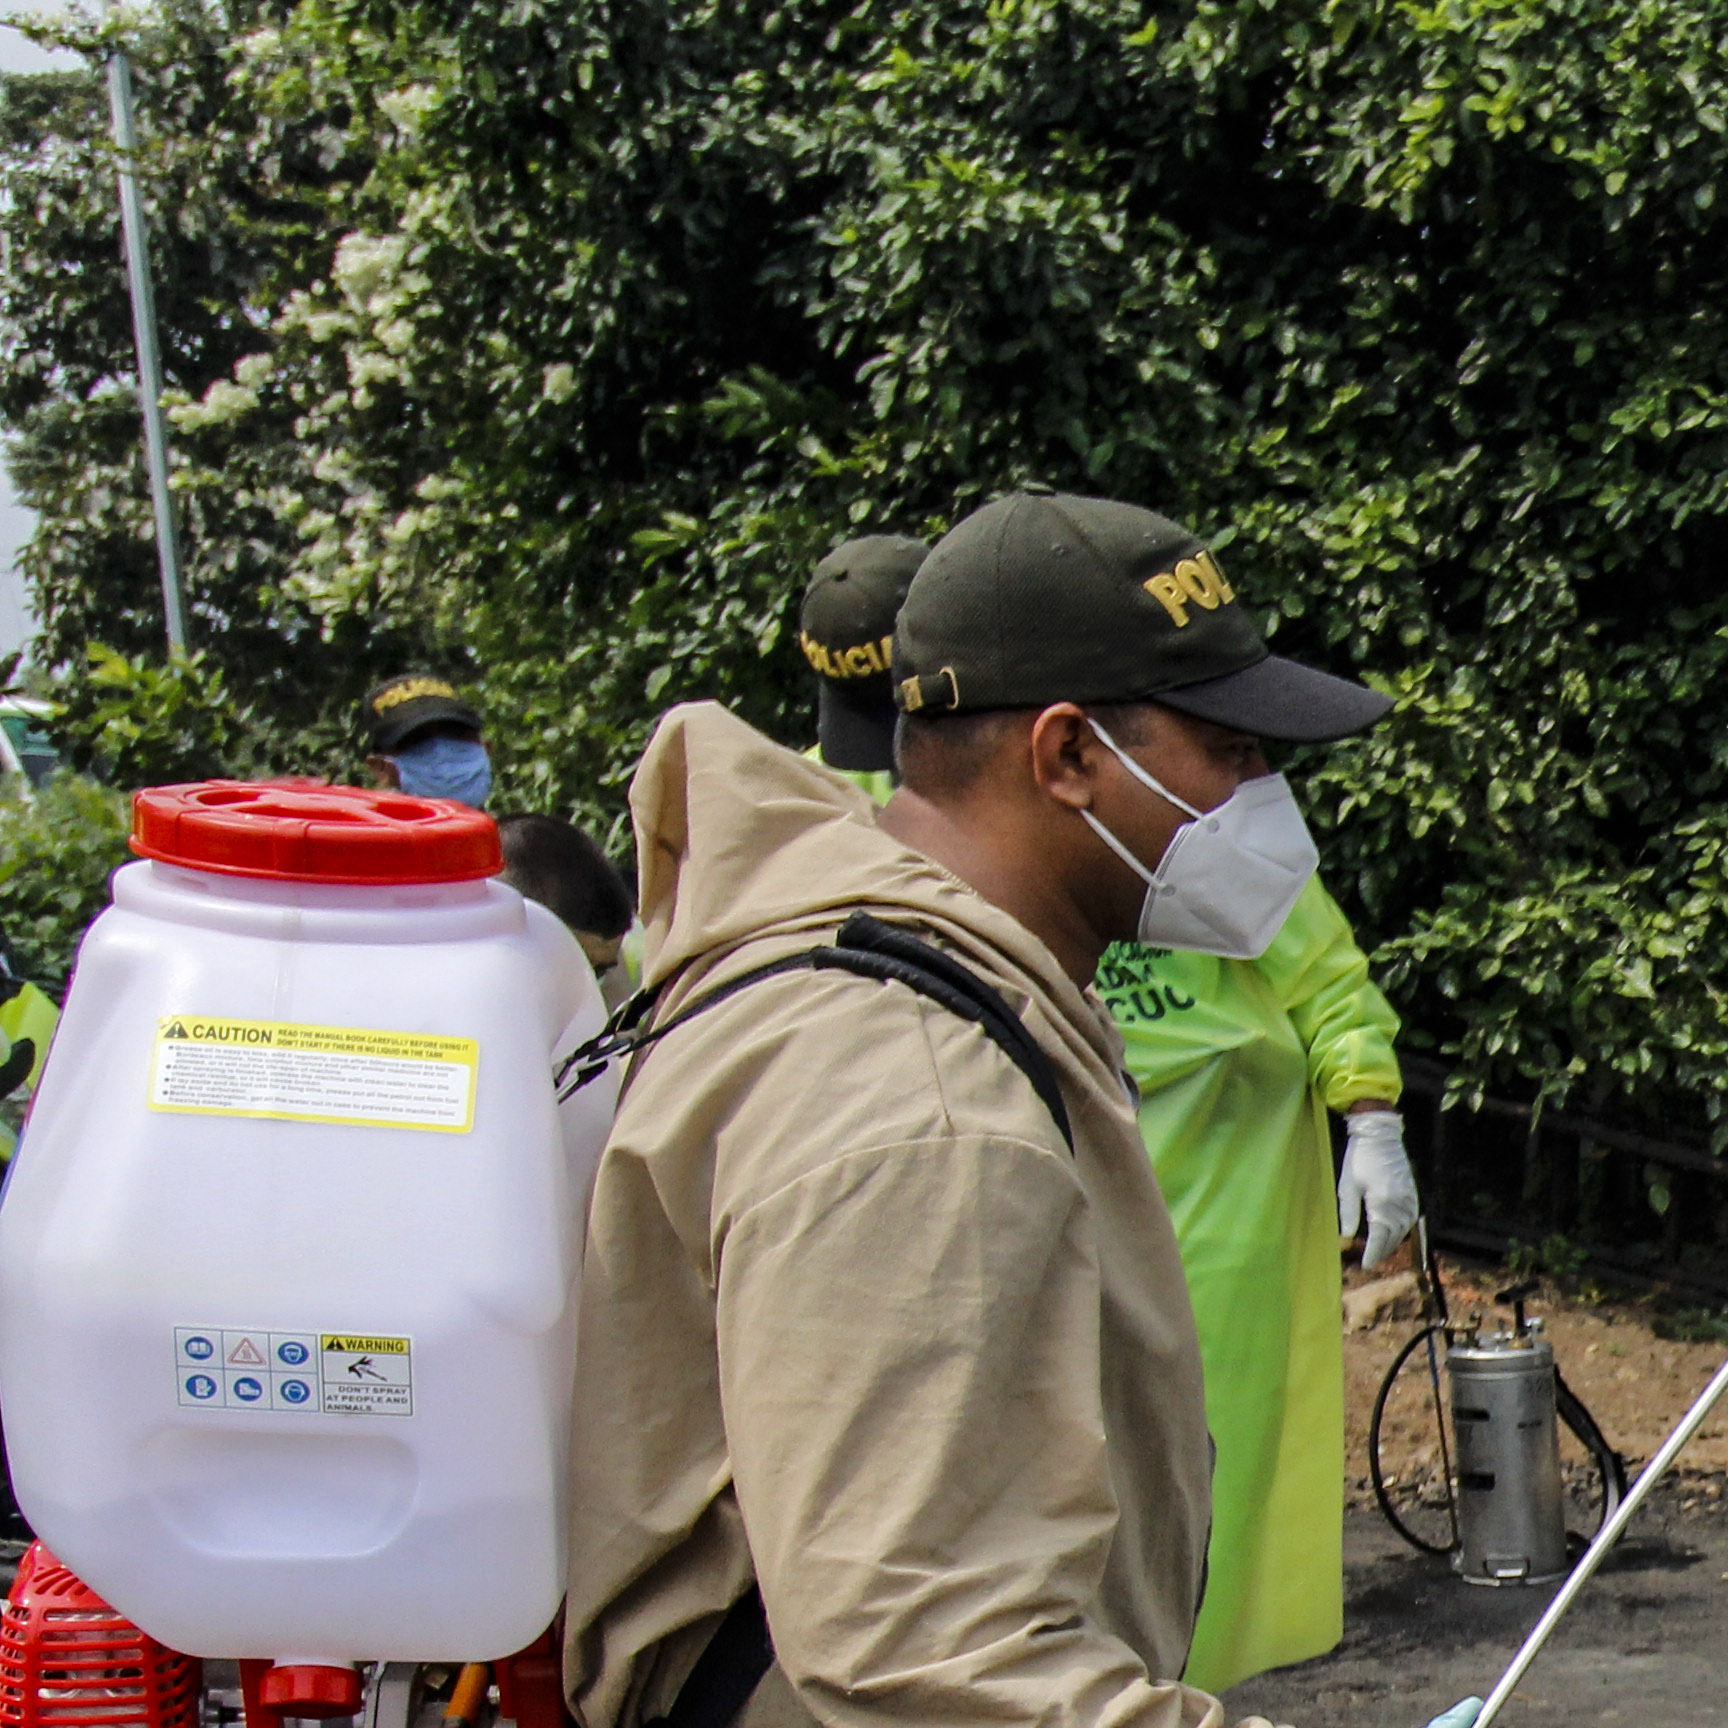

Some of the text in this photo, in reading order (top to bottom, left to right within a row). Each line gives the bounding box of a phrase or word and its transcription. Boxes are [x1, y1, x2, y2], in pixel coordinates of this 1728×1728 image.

[192, 1024, 273, 1044] CAUTION
[278, 1029, 298, 1037] READ
[299, 1031, 313, 1039] THE
[314, 1032, 344, 1041] MANUAL
[346, 1034, 366, 1042] BOOK
[367, 1035, 408, 1046] CAREFULLY
[410, 1040, 438, 1049] BEFORE
[439, 1042, 461, 1050] USING
[300, 1040, 323, 1048] START
[332, 1043, 356, 1052] THERE
[376, 1046, 401, 1055] LIQUID
[401, 1048, 409, 1056] IN
[410, 1049, 423, 1057] THE
[344, 1338, 405, 1353] WARNING
[338, 1385, 407, 1395] DON'T SPRAY
[326, 1394, 408, 1404] AT PEOPLE AND
